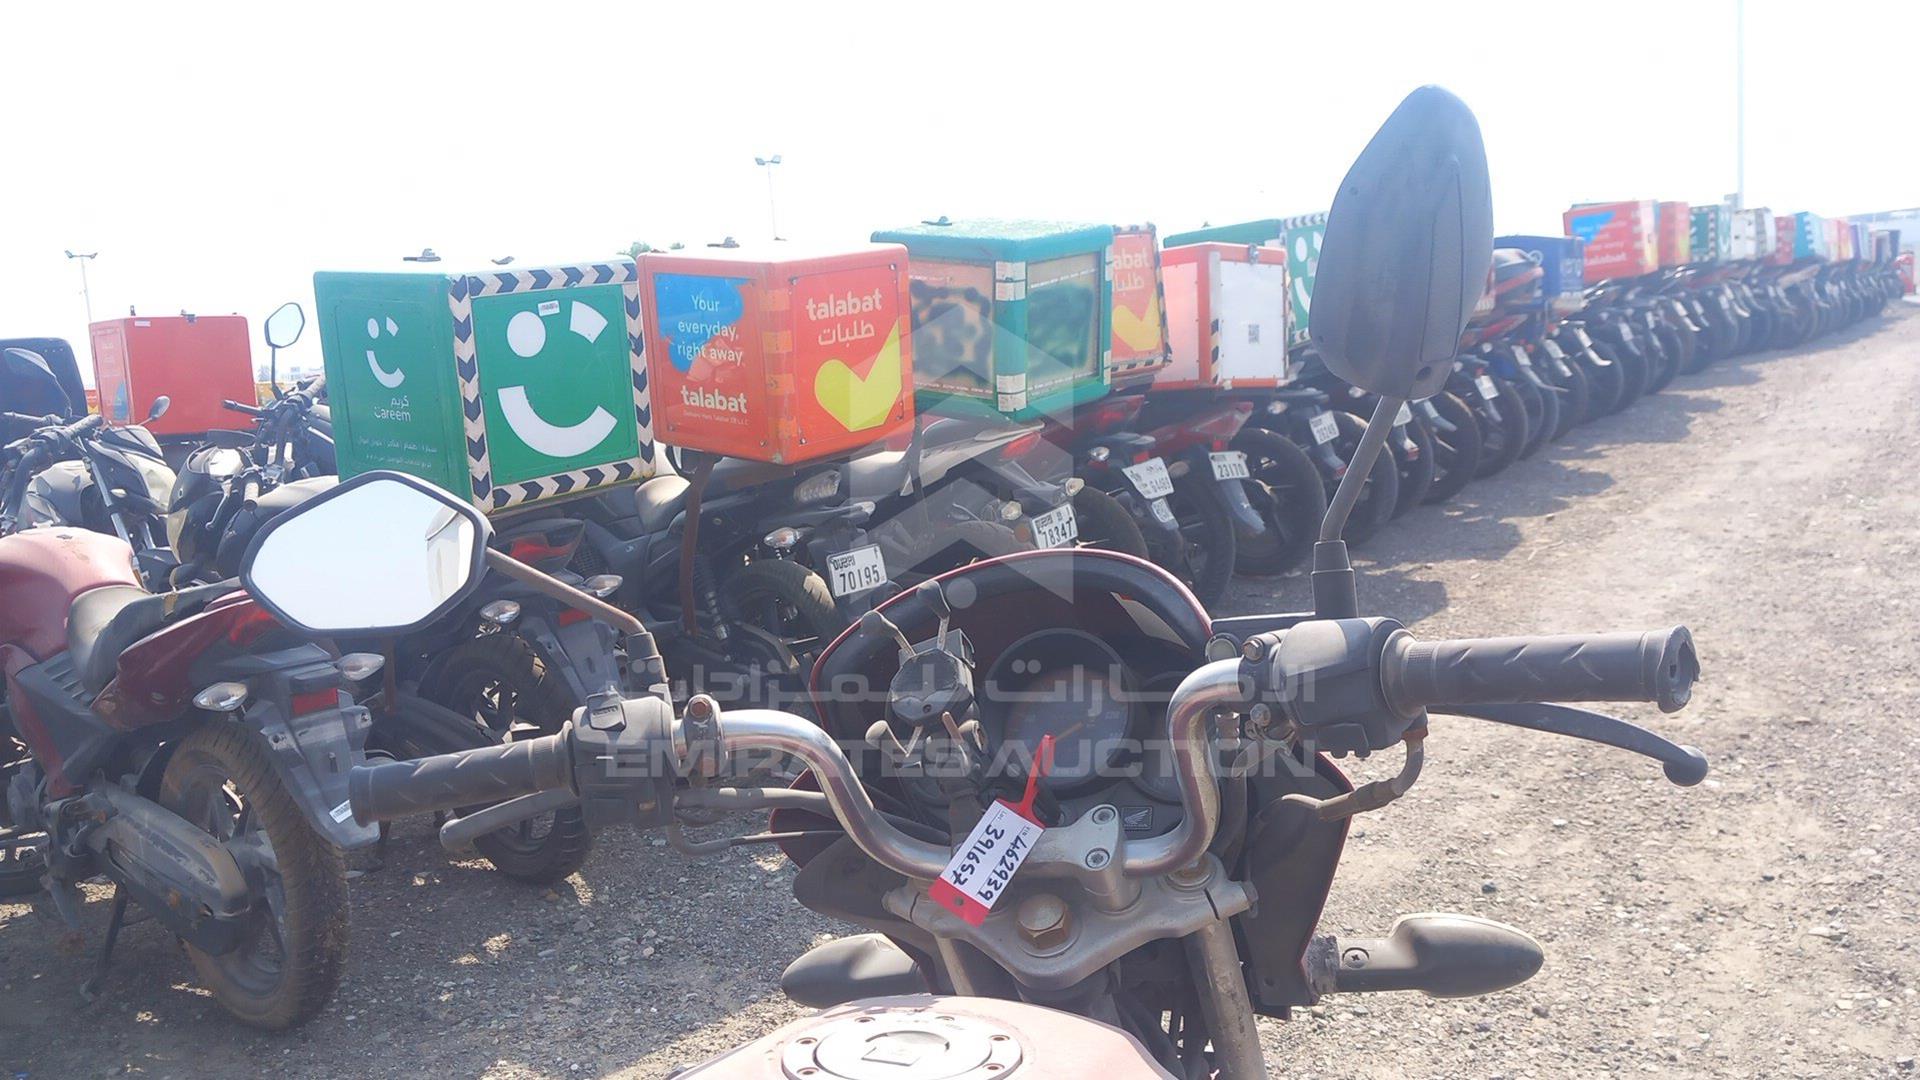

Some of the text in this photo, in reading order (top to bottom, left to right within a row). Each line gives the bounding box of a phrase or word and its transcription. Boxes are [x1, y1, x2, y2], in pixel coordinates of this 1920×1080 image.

[691, 295, 720, 312] Your
[806, 287, 882, 321] talabat
[678, 321, 738, 342] everyday,
[818, 320, 875, 348] طلبات
[677, 341, 706, 361] right
[391, 395, 410, 409] كريم
[680, 384, 747, 414] talabat
[374, 406, 412, 422] Careem
[1042, 520, 1073, 548] 78347
[839, 564, 880, 593] 70195
[952, 824, 1005, 886] 391657
[978, 835, 1028, 901] 462939
